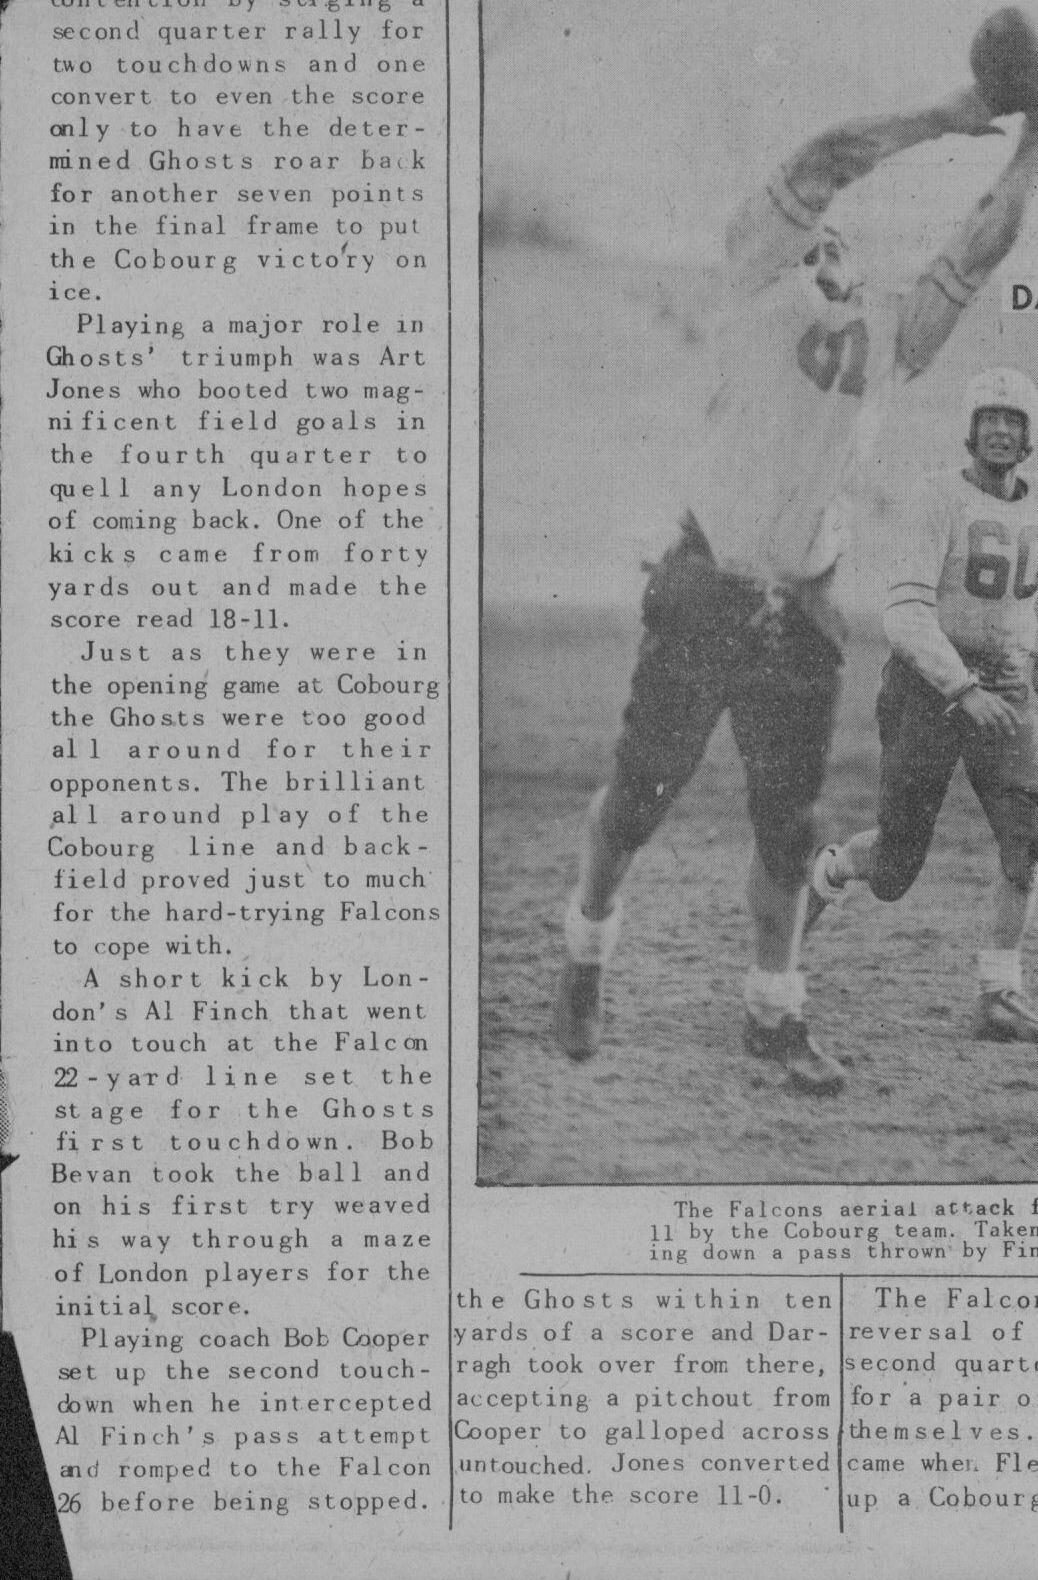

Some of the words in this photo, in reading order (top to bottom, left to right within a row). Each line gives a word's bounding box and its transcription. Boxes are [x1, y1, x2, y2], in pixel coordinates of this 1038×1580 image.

[51, 182, 92, 203] for
[111, 182, 218, 203] another
[238, 189, 311, 203] seven
[332, 187, 423, 208] points
[51, 615, 120, 628] score
[137, 608, 192, 628] read
[211, 608, 288, 629] 18-11.
[51, 706, 93, 727] the
[110, 706, 204, 727] Ghosts
[222, 713, 283, 726] were
[302, 710, 346, 726] too
[364, 706, 425, 732] good
[57, 1131, 142, 1151] first
[171, 1130, 352, 1151] touchdown.
[382, 1129, 433, 1150] Bob
[674, 1201, 712, 1218] The
[730, 1200, 822, 1218] Falcons
[840, 1199, 916, 1217] aerial
[652, 1225, 672, 1241] 11
[690, 1222, 713, 1243] by
[732, 1222, 768, 1239] the
[784, 1221, 878, 1242] Cobourg
[895, 1224, 954, 1238] team.
[651, 1250, 686, 1263] ing
[703, 1243, 754, 1260] down
[773, 1249, 782, 1259] a
[799, 1248, 851, 1264] pass
[868, 1242, 945, 1258] thrown
[963, 1241, 987, 1262] by
[846, 1351, 935, 1372] second
[58, 1492, 82, 1514] 26
[102, 1491, 194, 1511] before
[214, 1490, 289, 1516] being
[309, 1489, 427, 1516] stopped.
[460, 1489, 482, 1504] to
[498, 1483, 554, 1504] make
[572, 1483, 613, 1504] the
[630, 1491, 698, 1504] score
[719, 1485, 781, 1505] 11-0.
